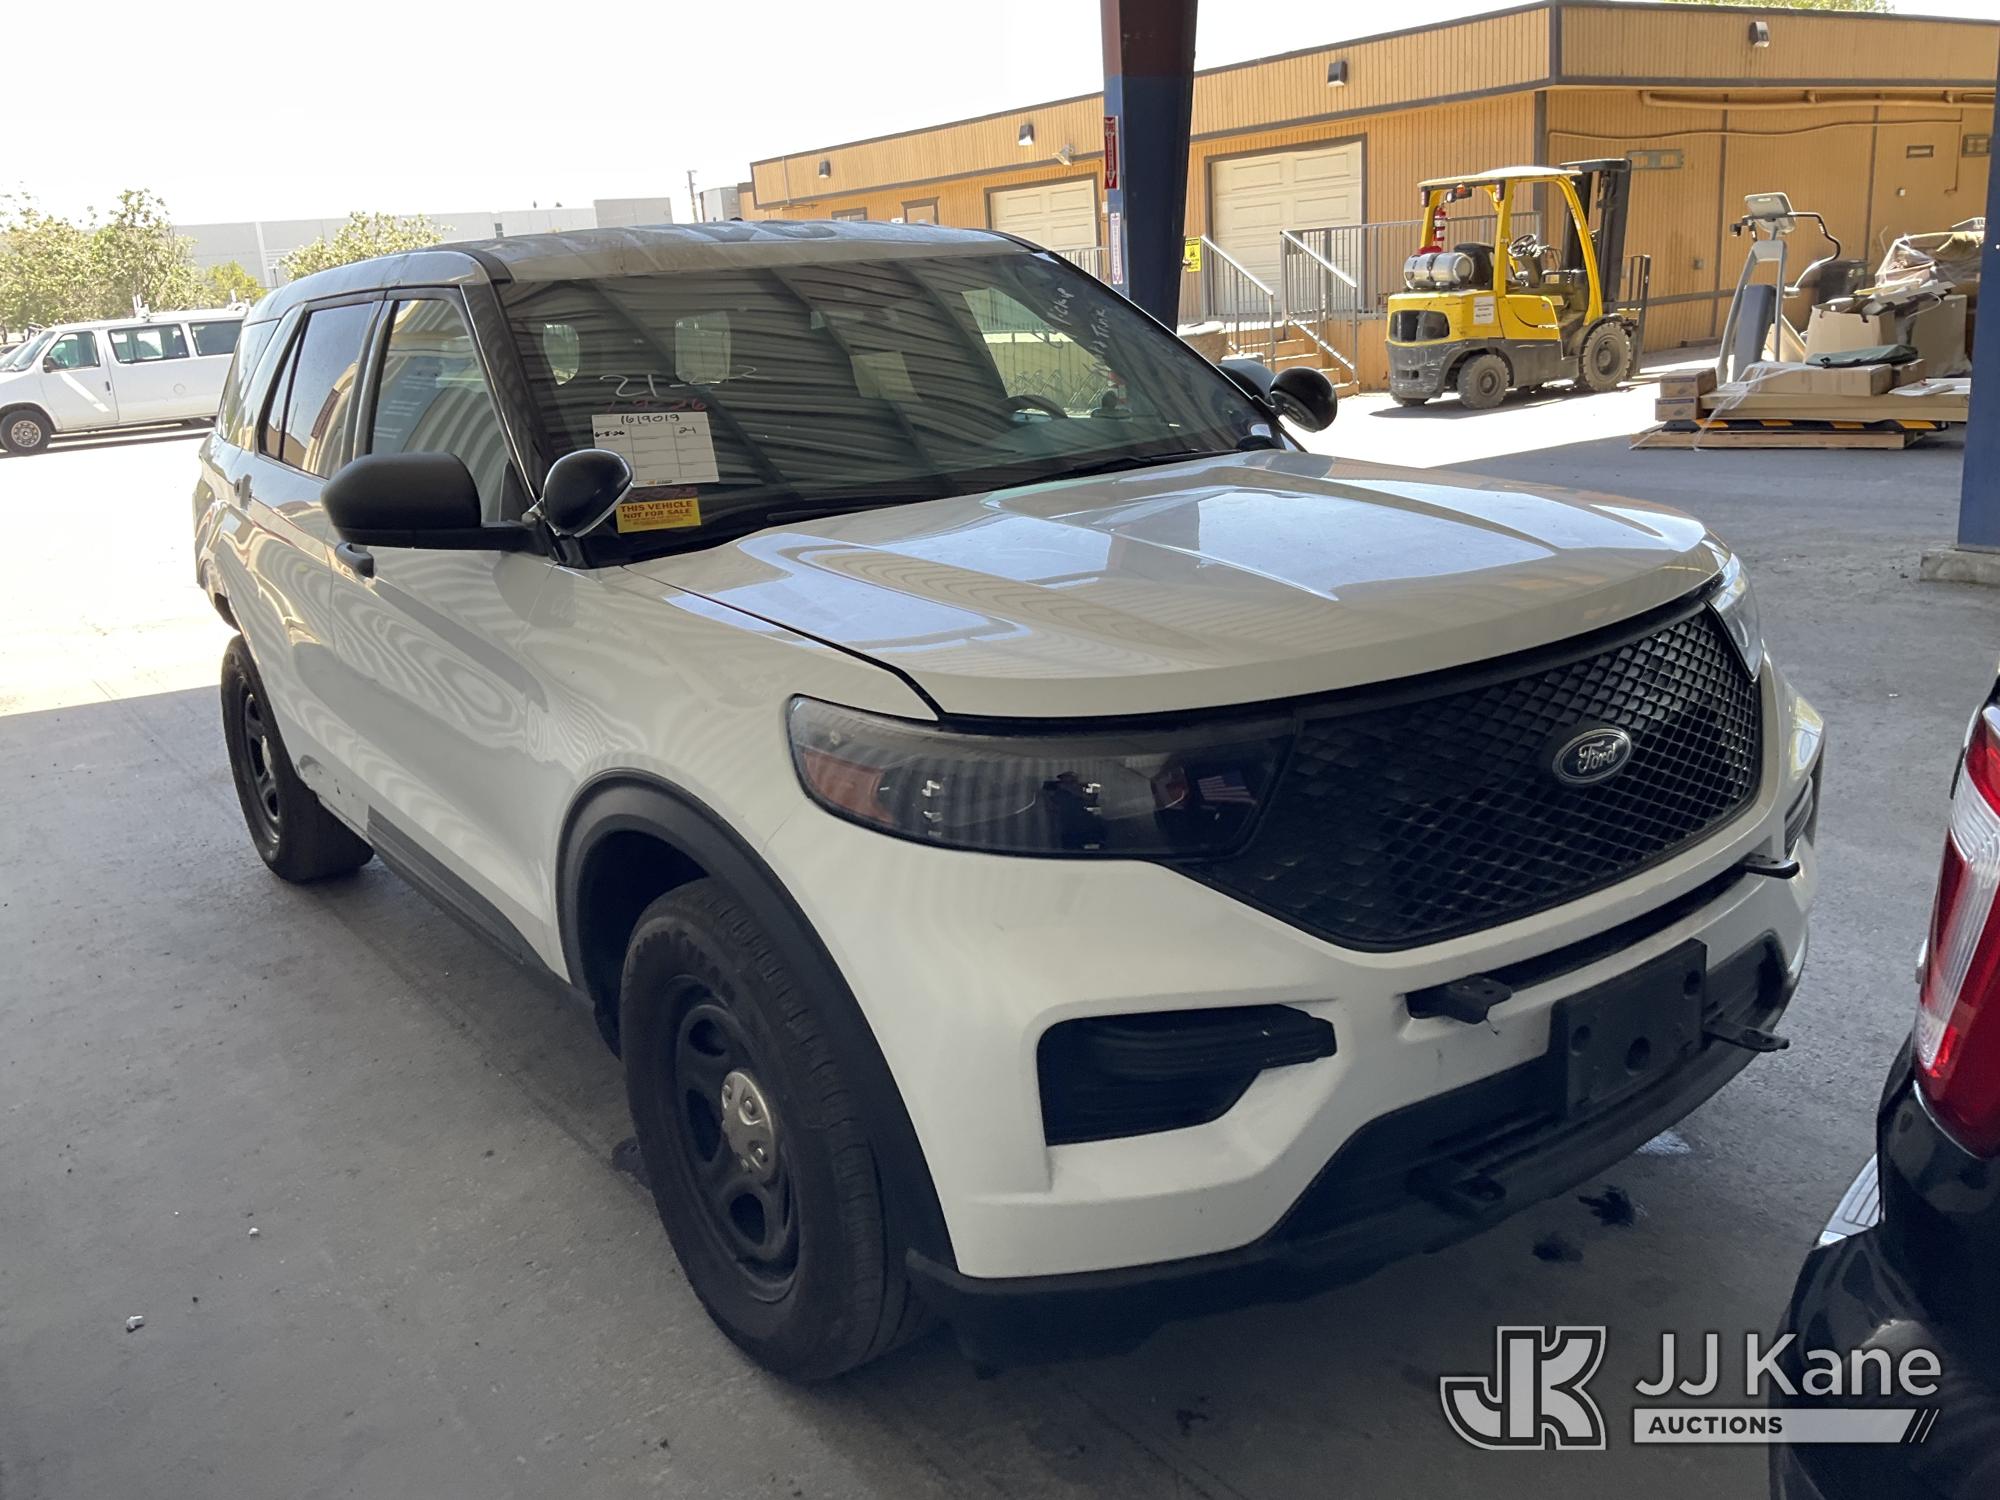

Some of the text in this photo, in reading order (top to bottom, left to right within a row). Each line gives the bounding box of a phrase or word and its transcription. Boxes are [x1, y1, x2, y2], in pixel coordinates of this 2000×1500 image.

[620, 413, 680, 425] 1619019
[621, 500, 693, 513] THIS VEHICLE
[1577, 740, 1617, 774] Ford
